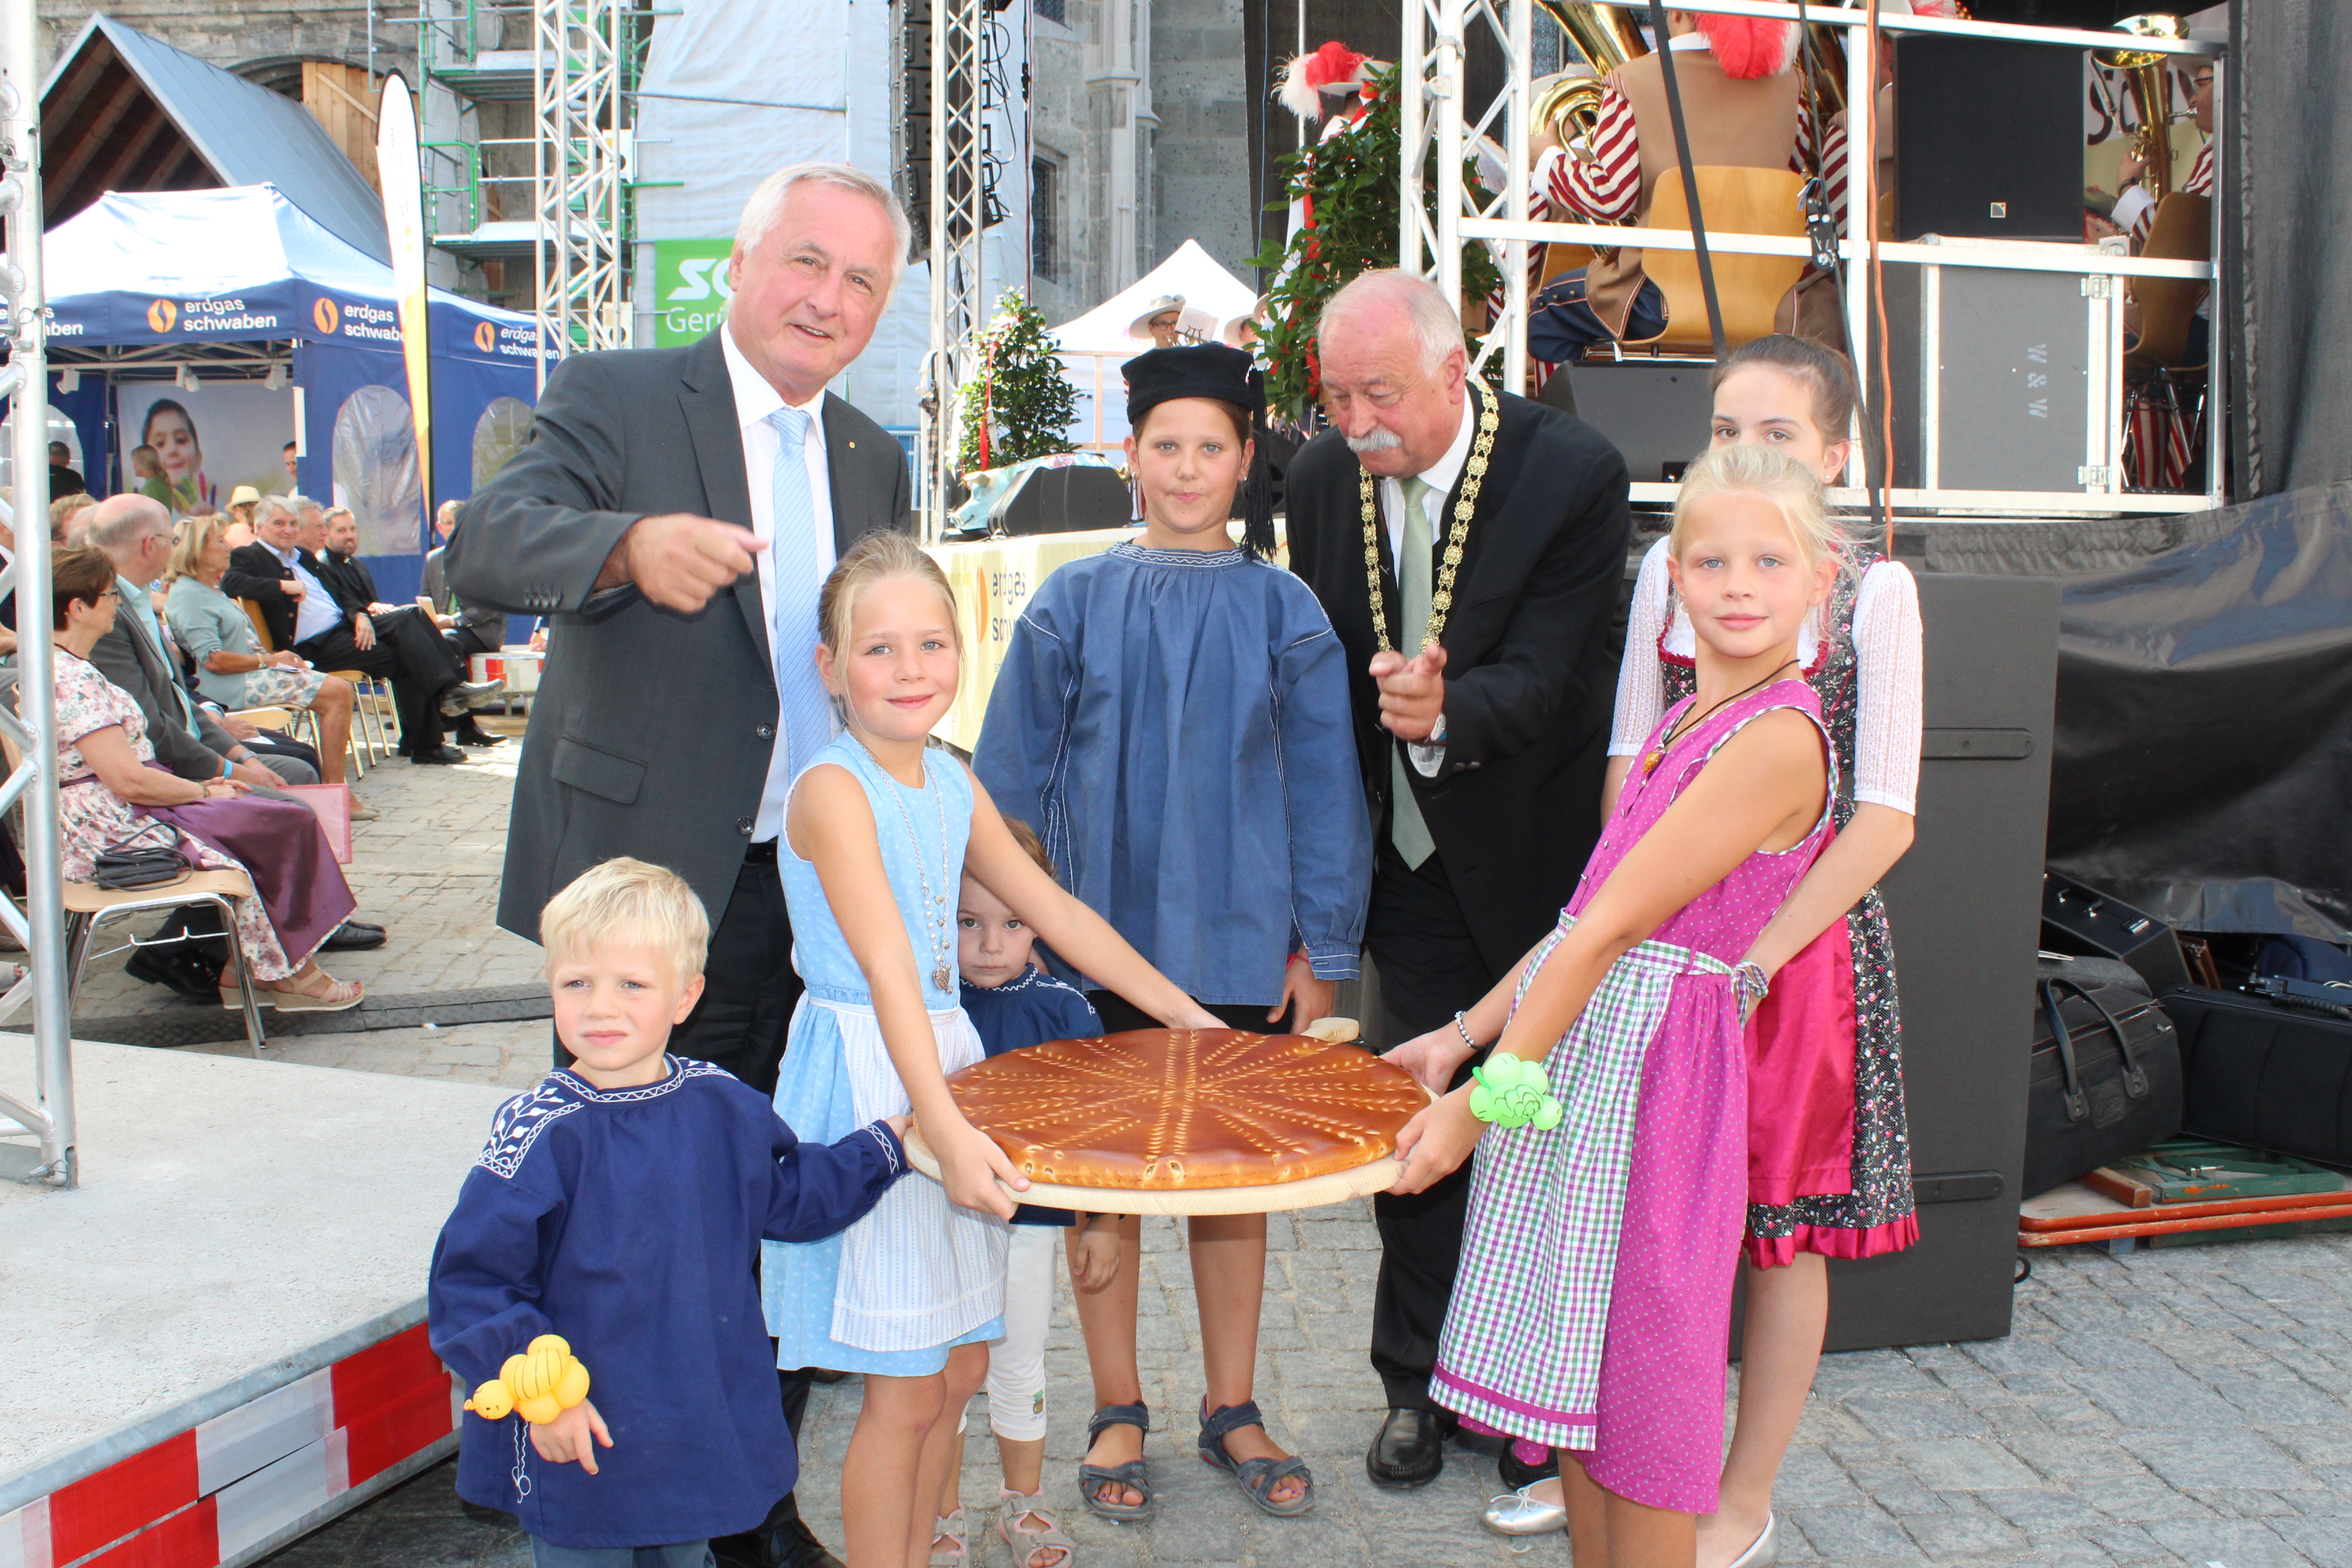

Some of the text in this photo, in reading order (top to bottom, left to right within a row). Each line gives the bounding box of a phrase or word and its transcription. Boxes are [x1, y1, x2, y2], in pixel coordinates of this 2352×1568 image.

[184, 297, 246, 315] erdgas
[344, 304, 394, 323] erdgas
[184, 313, 277, 331] schwaben
[500, 327, 538, 344] erdga
[500, 342, 560, 359] schwaen
